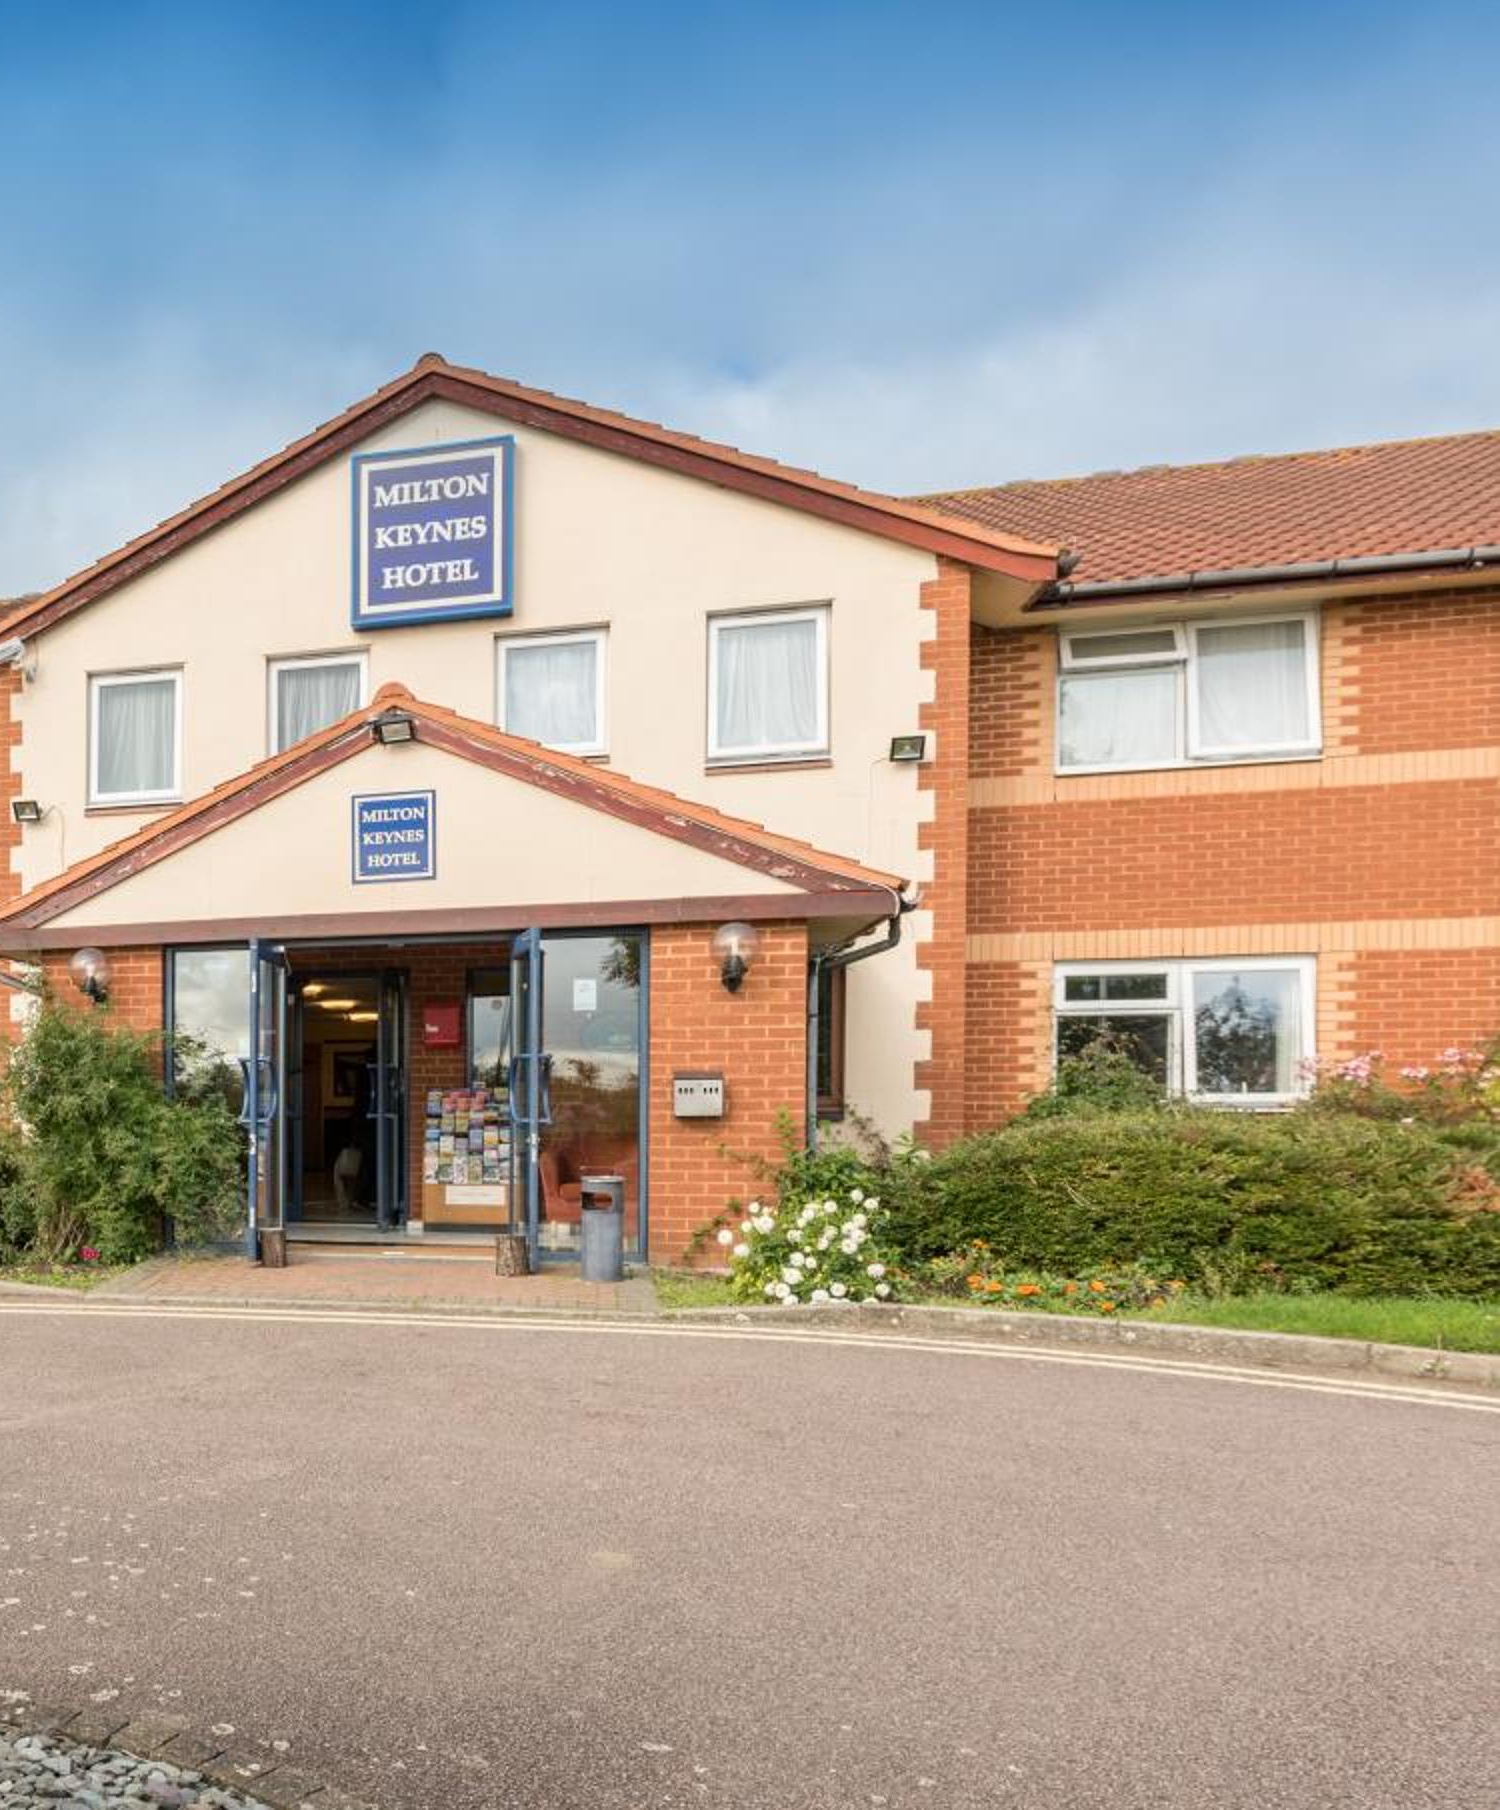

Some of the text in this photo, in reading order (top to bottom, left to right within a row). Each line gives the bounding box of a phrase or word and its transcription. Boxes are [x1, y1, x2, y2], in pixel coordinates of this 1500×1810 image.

[374, 473, 490, 507] MILTON
[375, 516, 487, 549] KEYNES
[381, 559, 479, 589] HOTEL
[362, 806, 425, 823] MILTON
[363, 829, 424, 845] KEYNES
[367, 852, 420, 867] HOTEL
